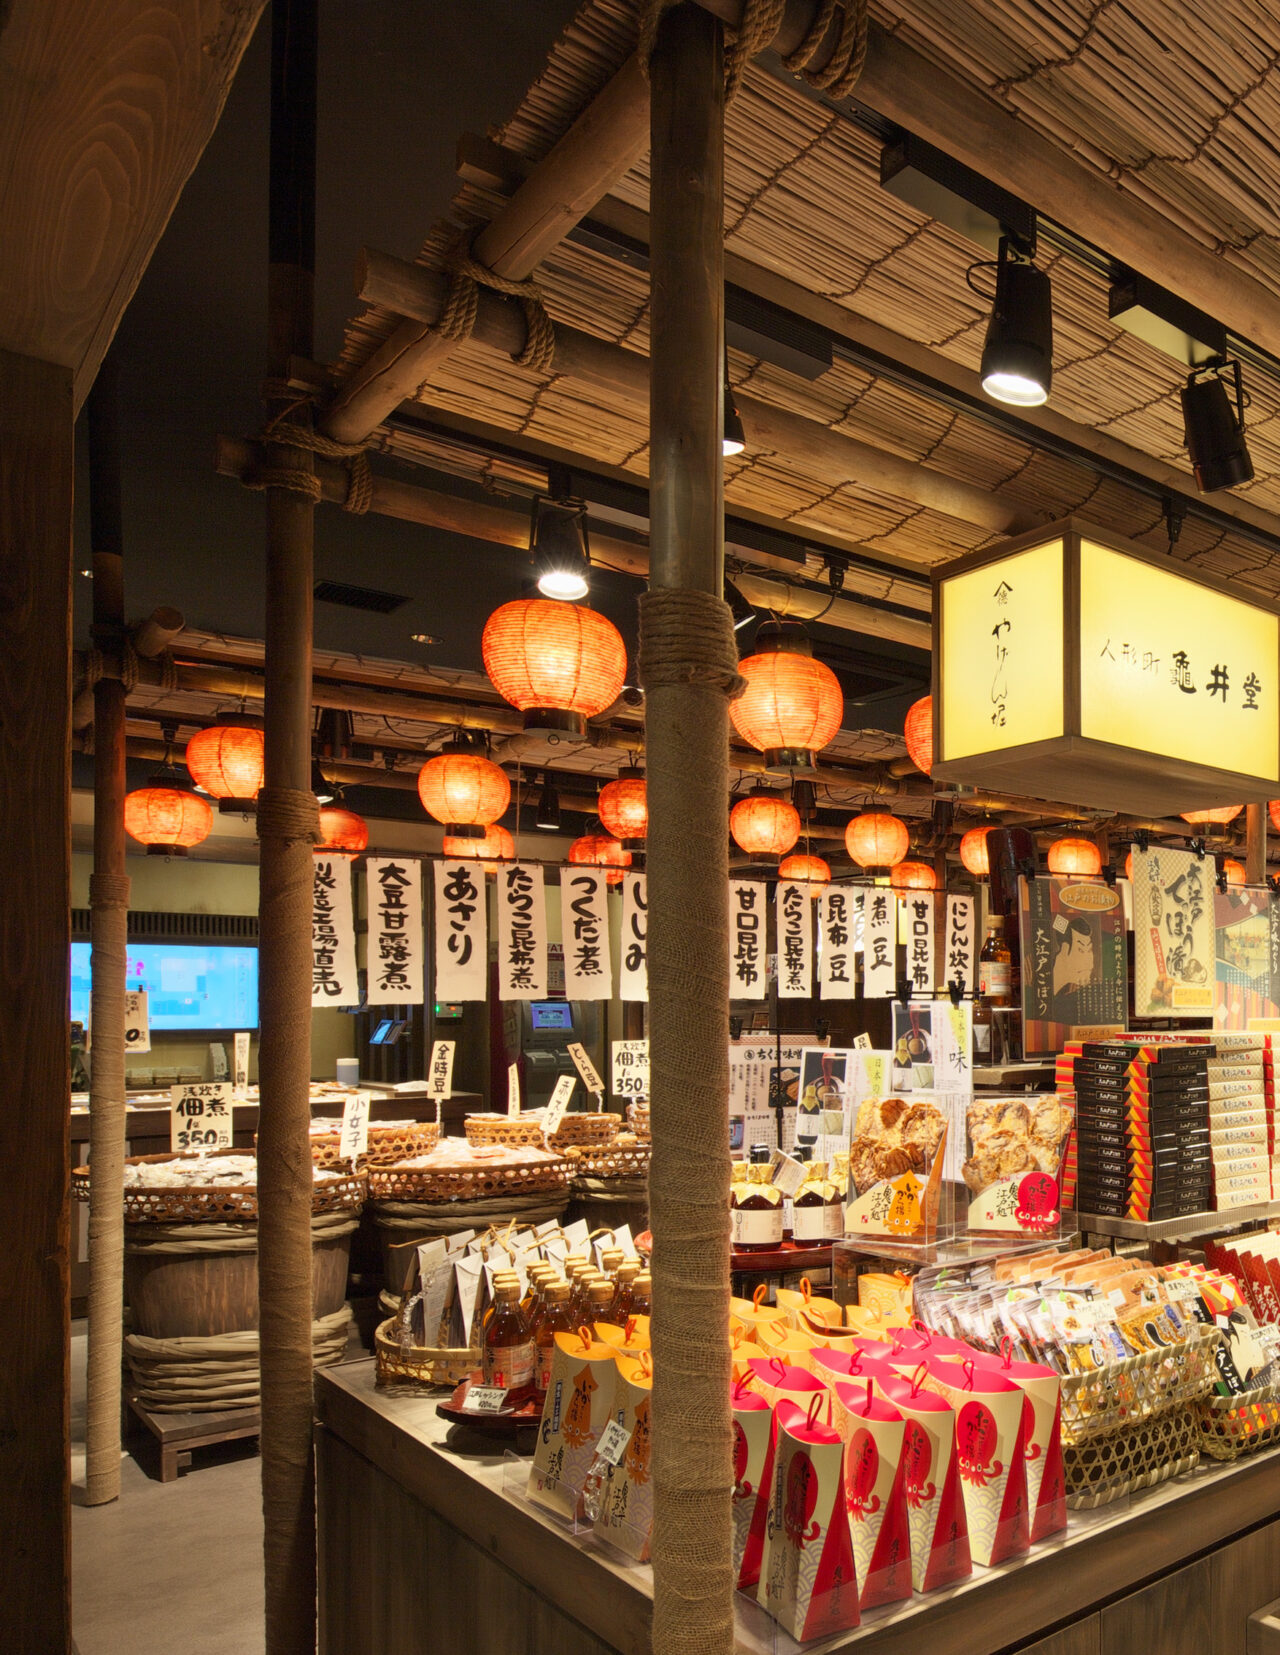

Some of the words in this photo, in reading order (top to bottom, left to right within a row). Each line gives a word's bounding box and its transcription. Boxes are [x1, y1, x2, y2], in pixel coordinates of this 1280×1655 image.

[1100, 637, 1161, 676] 人形町
[375, 862, 413, 991] 大豆甘露煮
[443, 866, 479, 966] あさり
[506, 866, 539, 989] たらこ昆布煮
[570, 876, 603, 977] つくだ煮
[734, 886, 759, 987] 甘口昆布
[783, 885, 806, 991] たらこ昆布煮
[826, 894, 850, 983] 昆布豆
[870, 896, 893, 970] 煮豆
[911, 899, 930, 990] 甘口昆布
[1034, 927, 1051, 1017] 大江戸ごぼう
[175, 1097, 230, 1118] 佃煮
[432, 1043, 450, 1094] 金時豆
[177, 1129, 229, 1150] 350円
[347, 1099, 367, 1148] 小女子
